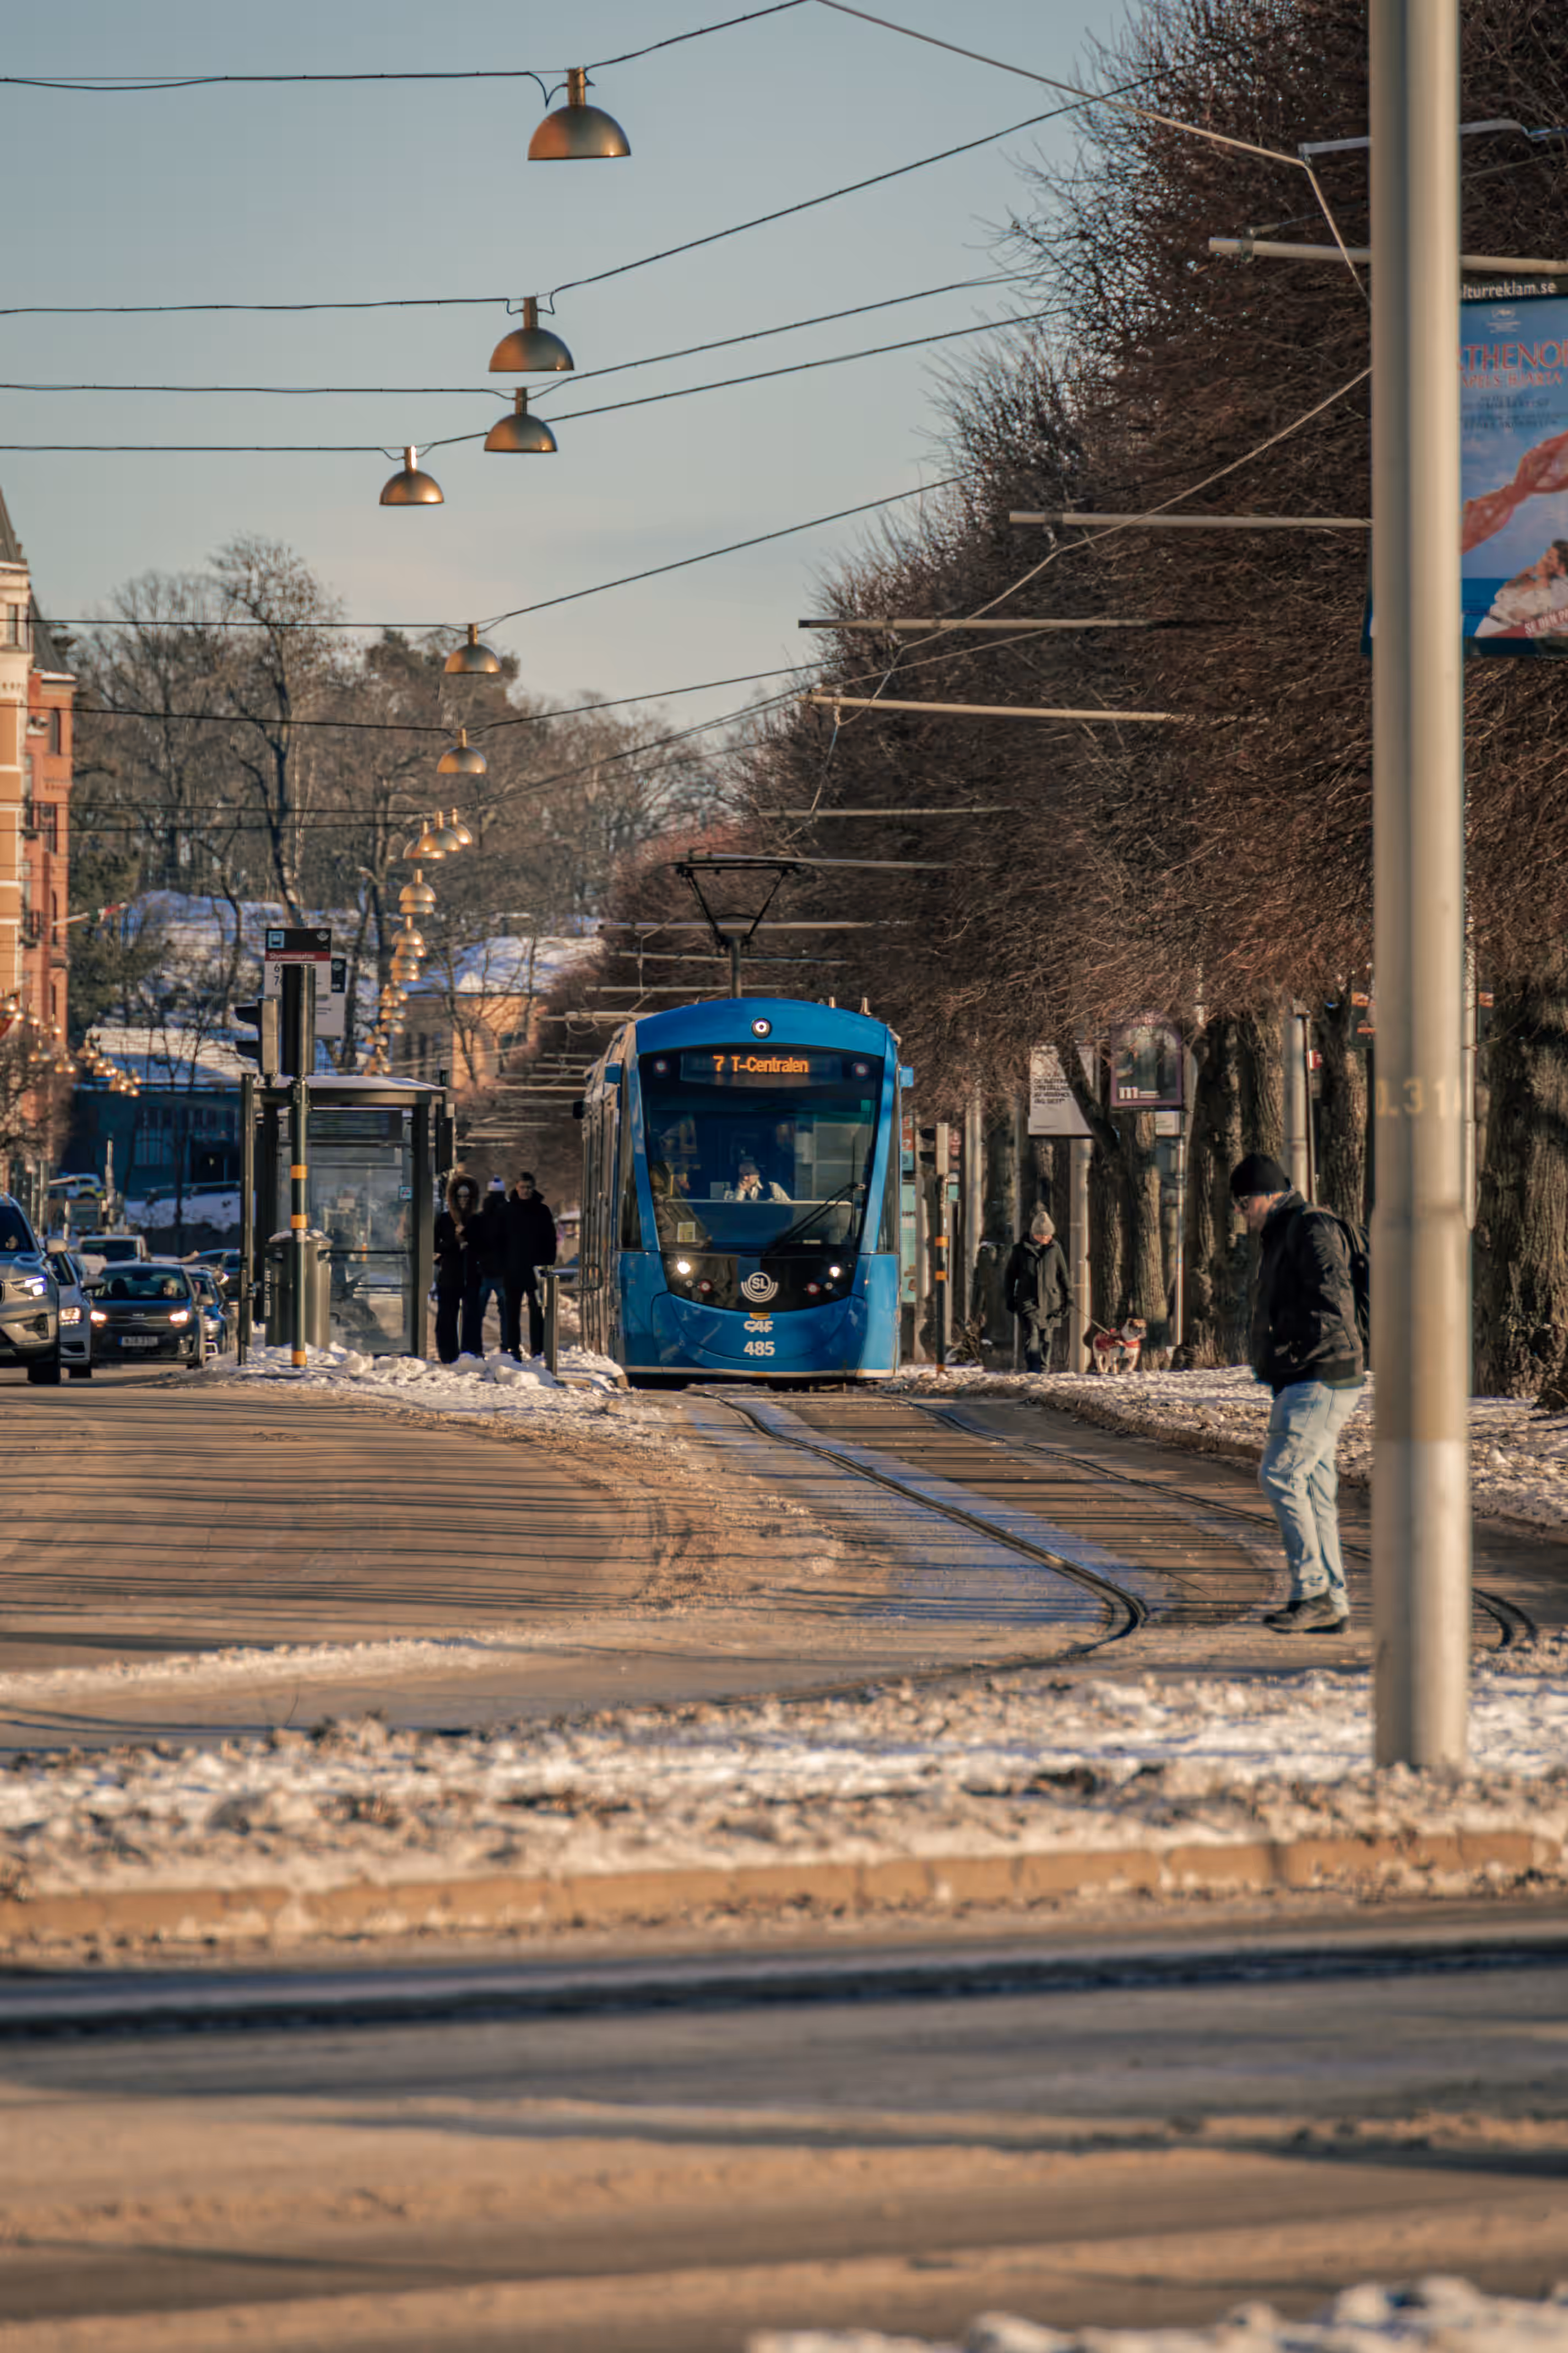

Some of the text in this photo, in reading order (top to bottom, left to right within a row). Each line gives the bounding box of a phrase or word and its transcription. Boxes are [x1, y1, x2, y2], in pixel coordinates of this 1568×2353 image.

[1460, 280, 1557, 299] lturreklam.se
[713, 1055, 809, 1073] 7 T-Centralen
[751, 1277, 767, 1290] SL
[743, 1341, 776, 1356] 485
